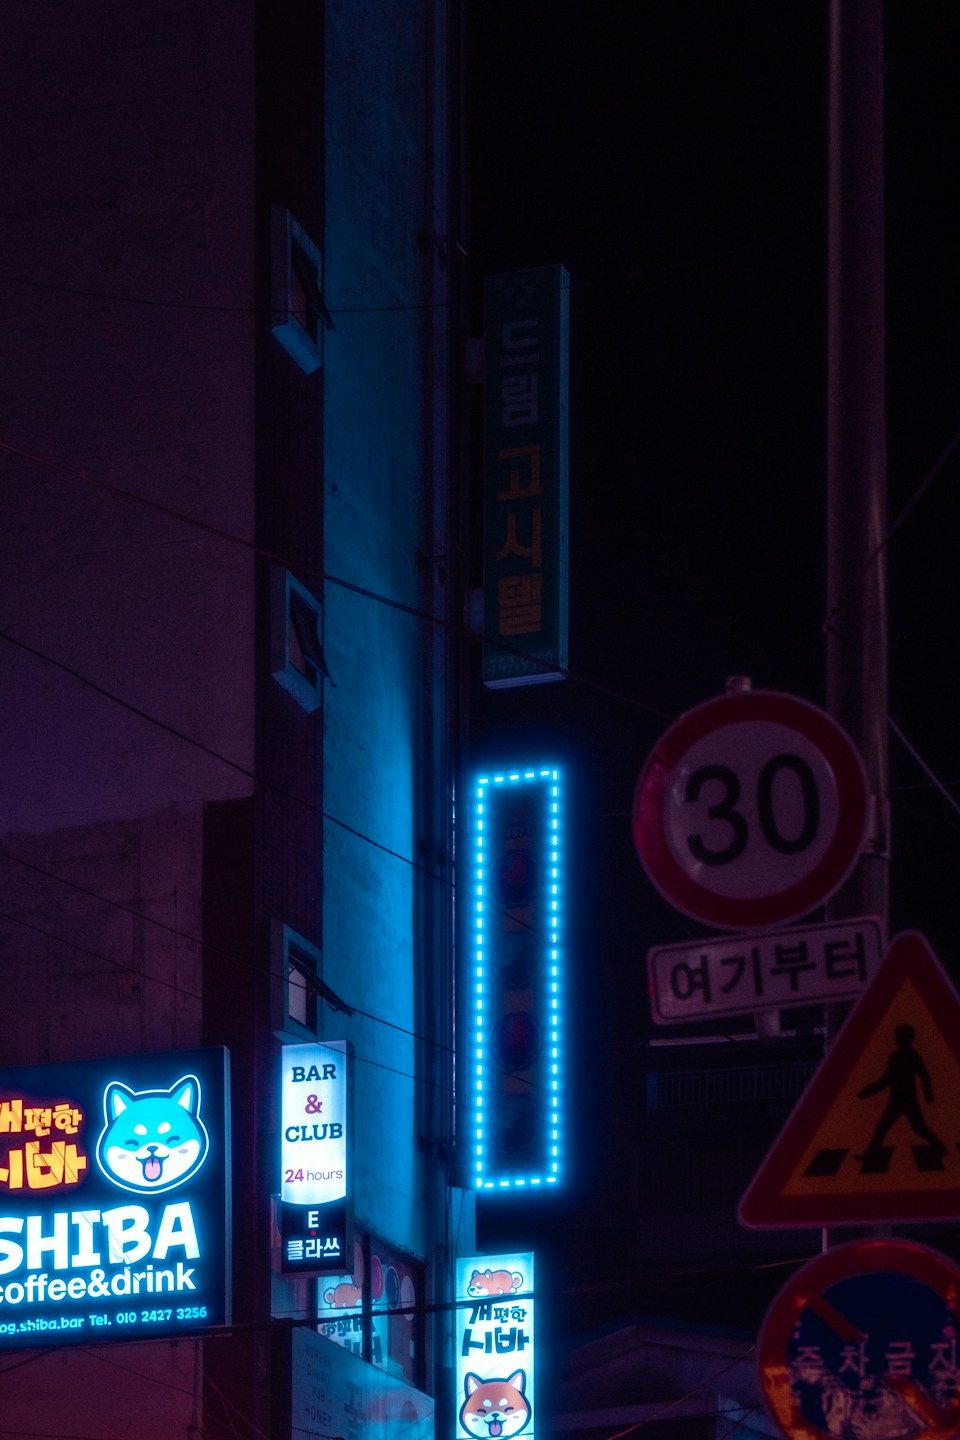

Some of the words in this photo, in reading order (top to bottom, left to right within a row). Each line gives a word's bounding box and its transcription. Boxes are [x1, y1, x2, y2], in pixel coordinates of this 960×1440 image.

[496, 442, 543, 637] 고시텔
[685, 754, 819, 865] 30
[670, 933, 867, 1003] 여기부터
[292, 1063, 337, 1082] BAR
[305, 1094, 323, 1114] &
[285, 1123, 343, 1142] CLUB
[285, 1169, 304, 1183] 24
[306, 1168, 343, 1182] hours
[307, 1211, 319, 1228] E
[287, 1238, 340, 1260] 클라쓰
[89, 1313, 112, 1326] Tel.
[116, 1310, 138, 1324] 010
[141, 1309, 172, 1322] 2427
[176, 1306, 207, 1319] 3256
[462, 1327, 530, 1356] 시바
